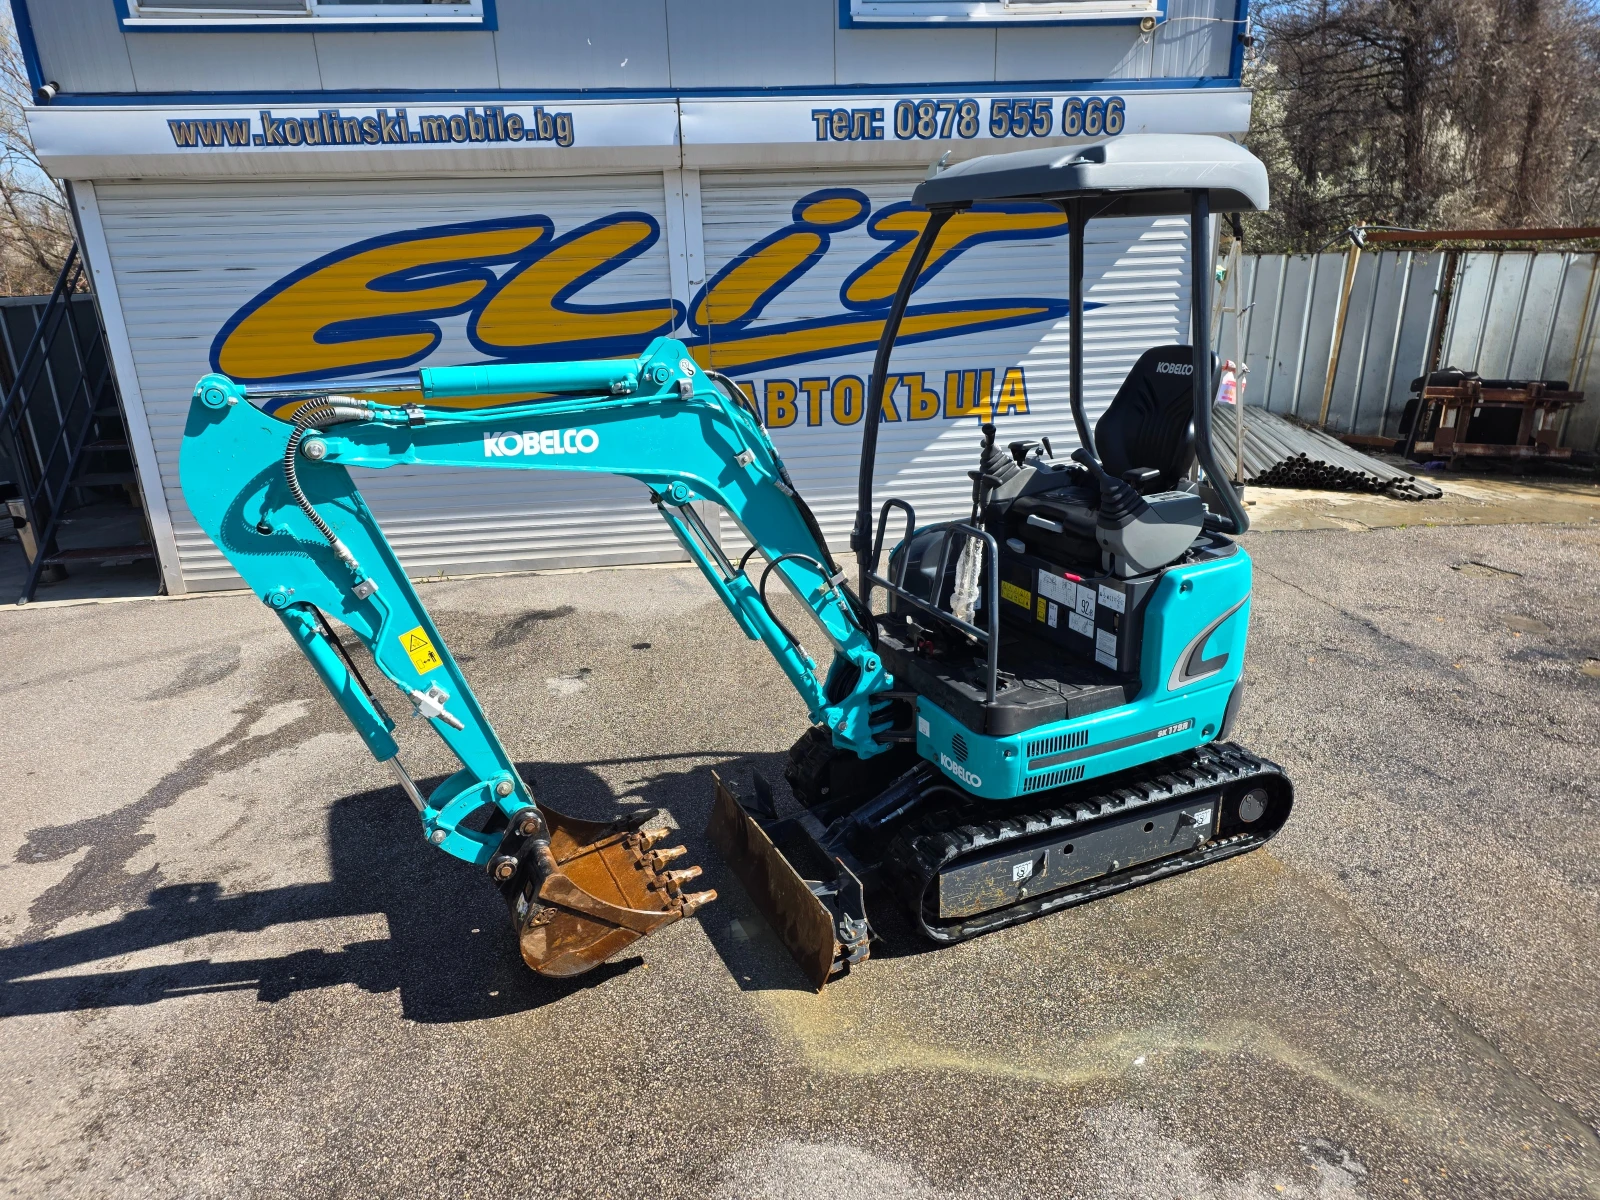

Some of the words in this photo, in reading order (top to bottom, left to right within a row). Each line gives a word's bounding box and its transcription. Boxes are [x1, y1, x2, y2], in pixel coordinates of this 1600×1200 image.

[168, 106, 574, 147] www.koulinski.mobile.bg
[812, 108, 884, 141] тел:
[895, 98, 979, 140] 0878
[989, 98, 1052, 137] 555
[1061, 97, 1125, 136] 666
[1156, 361, 1194, 376] KOBELCO
[483, 428, 600, 457] KOBELCO
[940, 751, 982, 788] KOBELCO
